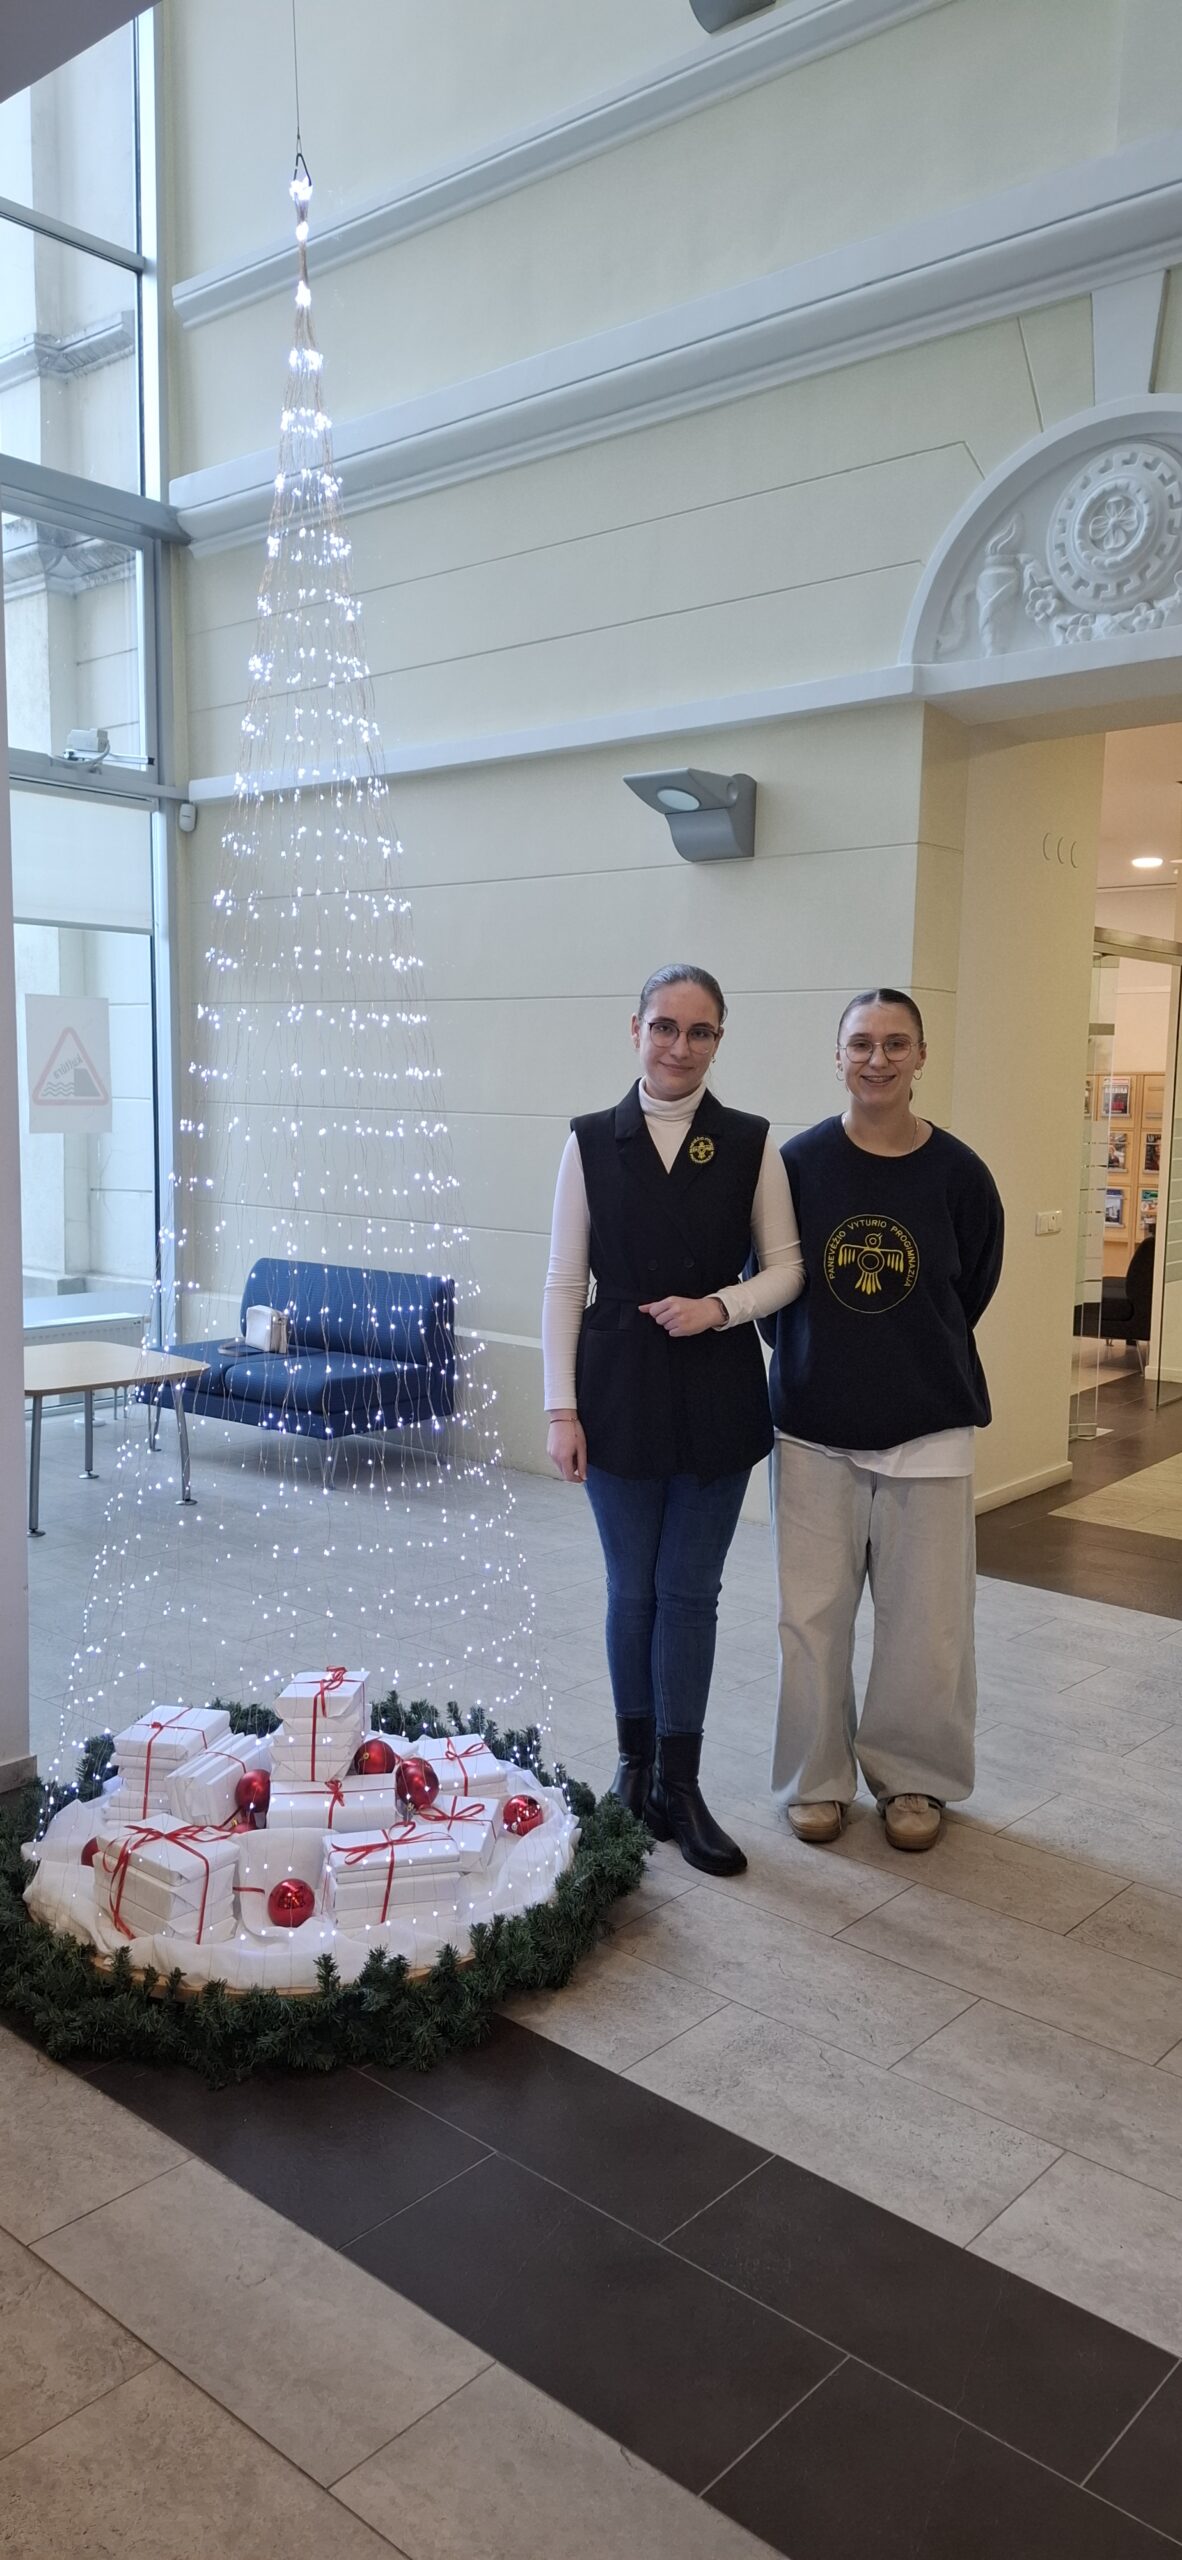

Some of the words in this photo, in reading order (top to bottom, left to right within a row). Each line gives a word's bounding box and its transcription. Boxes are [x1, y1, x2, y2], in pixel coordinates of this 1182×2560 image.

[827, 1230, 847, 1280] PANEVĖŽIO
[847, 1219, 887, 1230] VYTURIO
[890, 1226, 916, 1287] PROGIMNAZIJA
